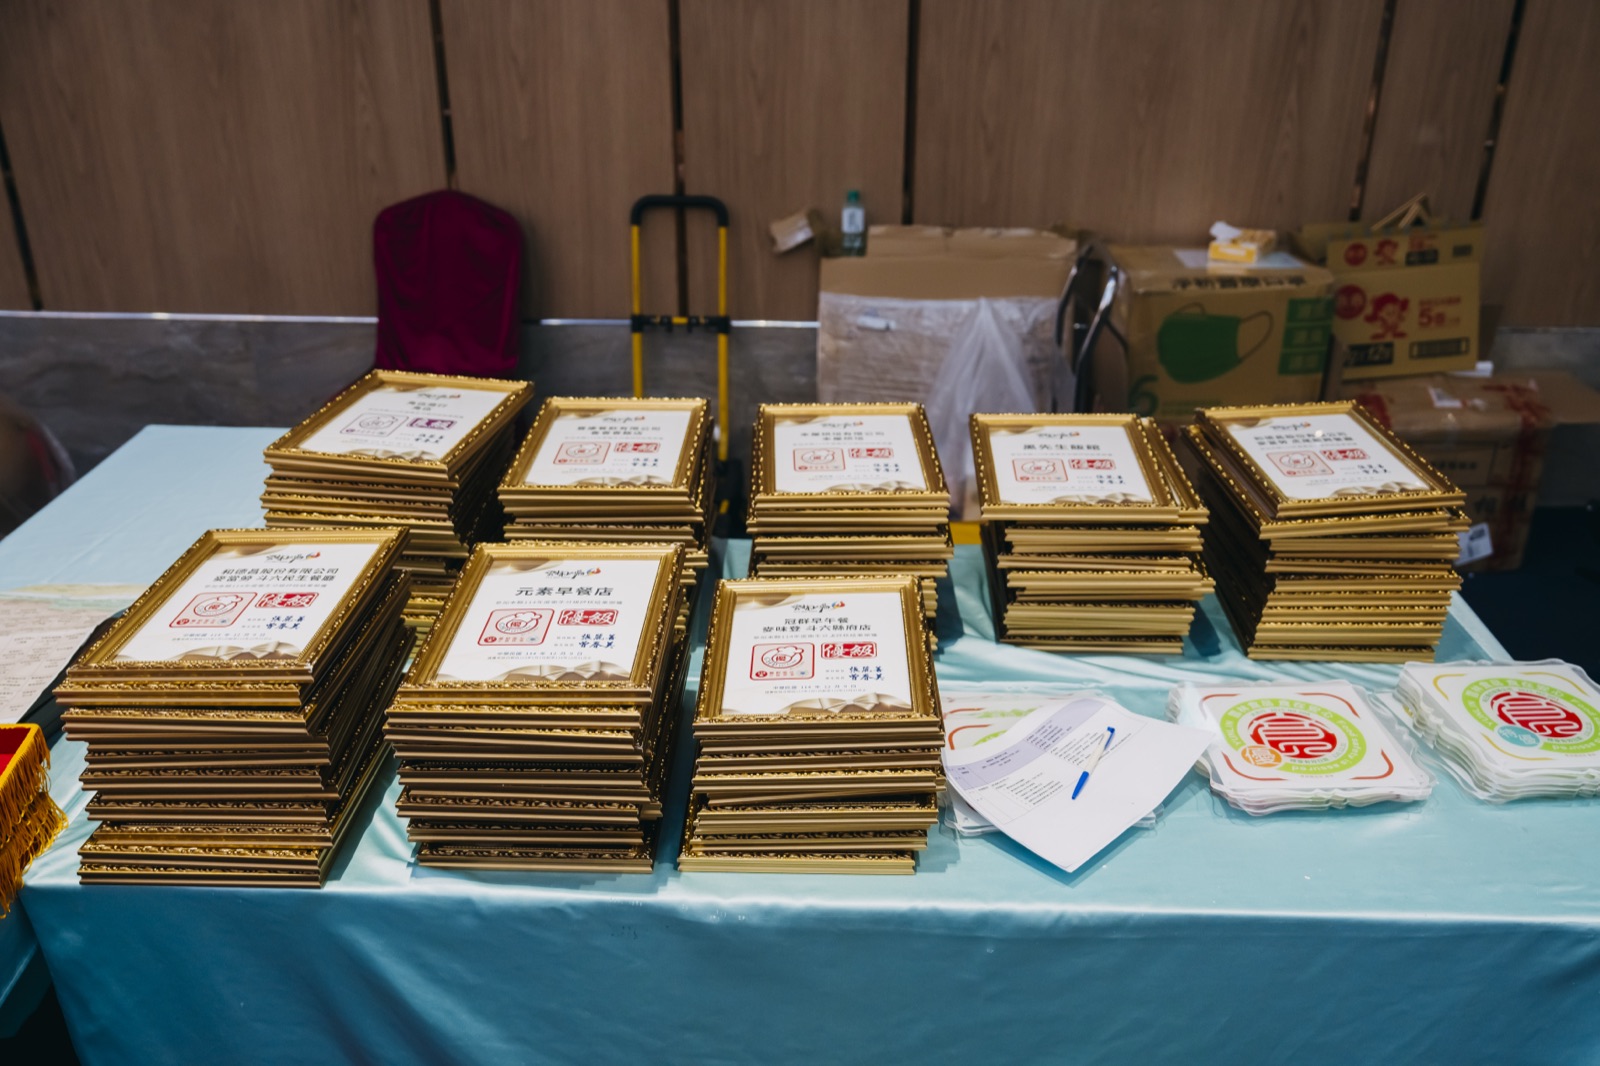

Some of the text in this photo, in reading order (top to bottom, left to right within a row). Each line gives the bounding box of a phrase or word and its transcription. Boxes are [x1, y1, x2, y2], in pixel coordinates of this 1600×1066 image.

[515, 586, 614, 597] 元素早餐店
[558, 609, 618, 626] 優級
[822, 642, 876, 659] 優級
